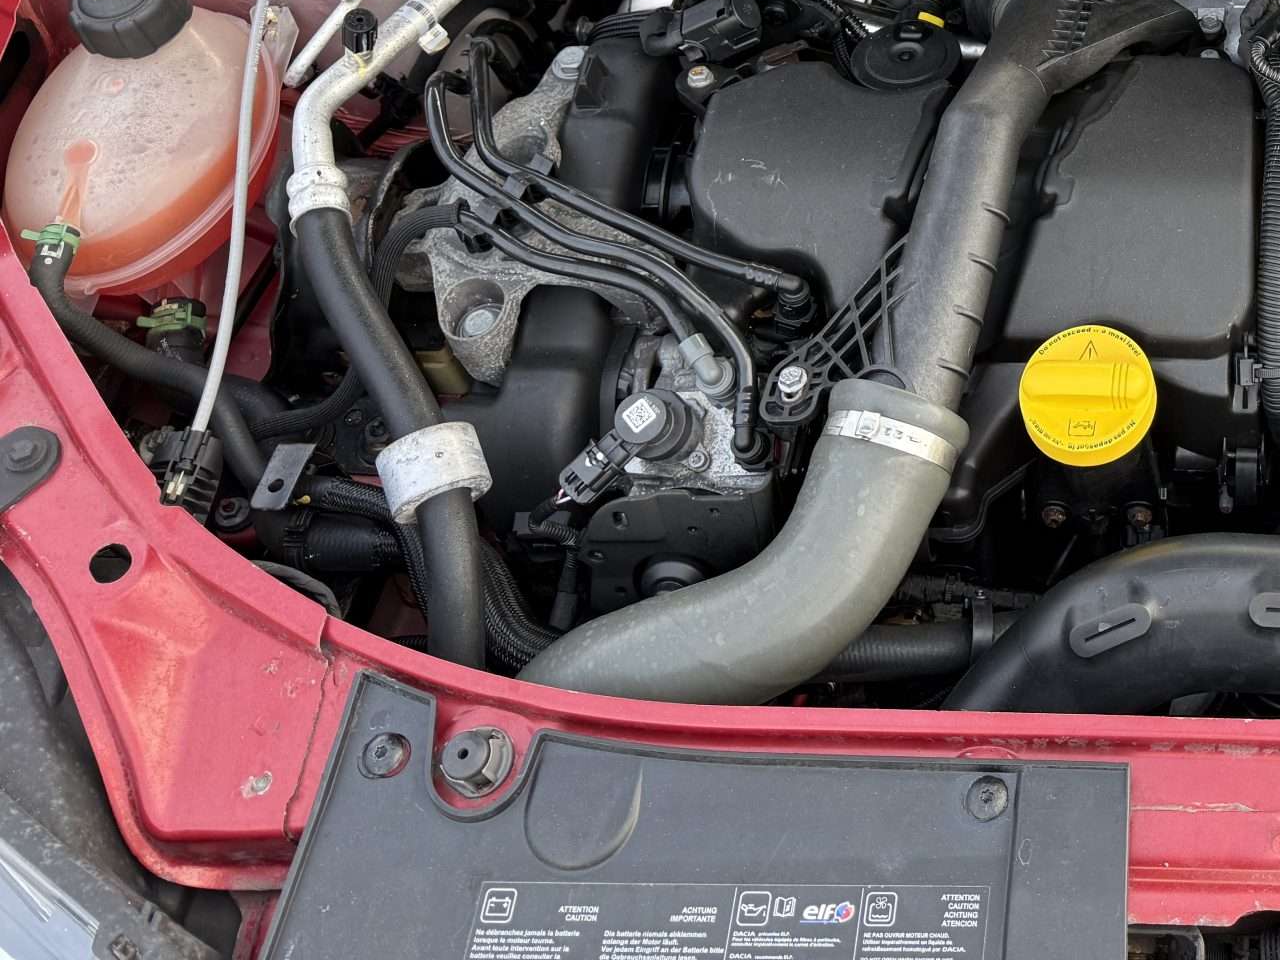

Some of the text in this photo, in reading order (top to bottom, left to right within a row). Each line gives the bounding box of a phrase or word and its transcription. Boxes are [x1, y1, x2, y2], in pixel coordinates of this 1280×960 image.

[1038, 345, 1049, 356] Do
[1048, 335, 1062, 347] not
[1063, 327, 1092, 338] exceed
[1126, 340, 1142, 357] level
[940, 894, 981, 902] ATTENTION
[558, 905, 600, 913] ATTENTION
[947, 902, 980, 910] CAUTION
[682, 907, 718, 915] ACHTUNG
[802, 904, 836, 920] elf
[943, 911, 979, 919] ACHTUNG
[565, 914, 598, 922] CAUTION
[669, 915, 717, 923] IMPORTANTE
[940, 920, 978, 928] ATENCION
